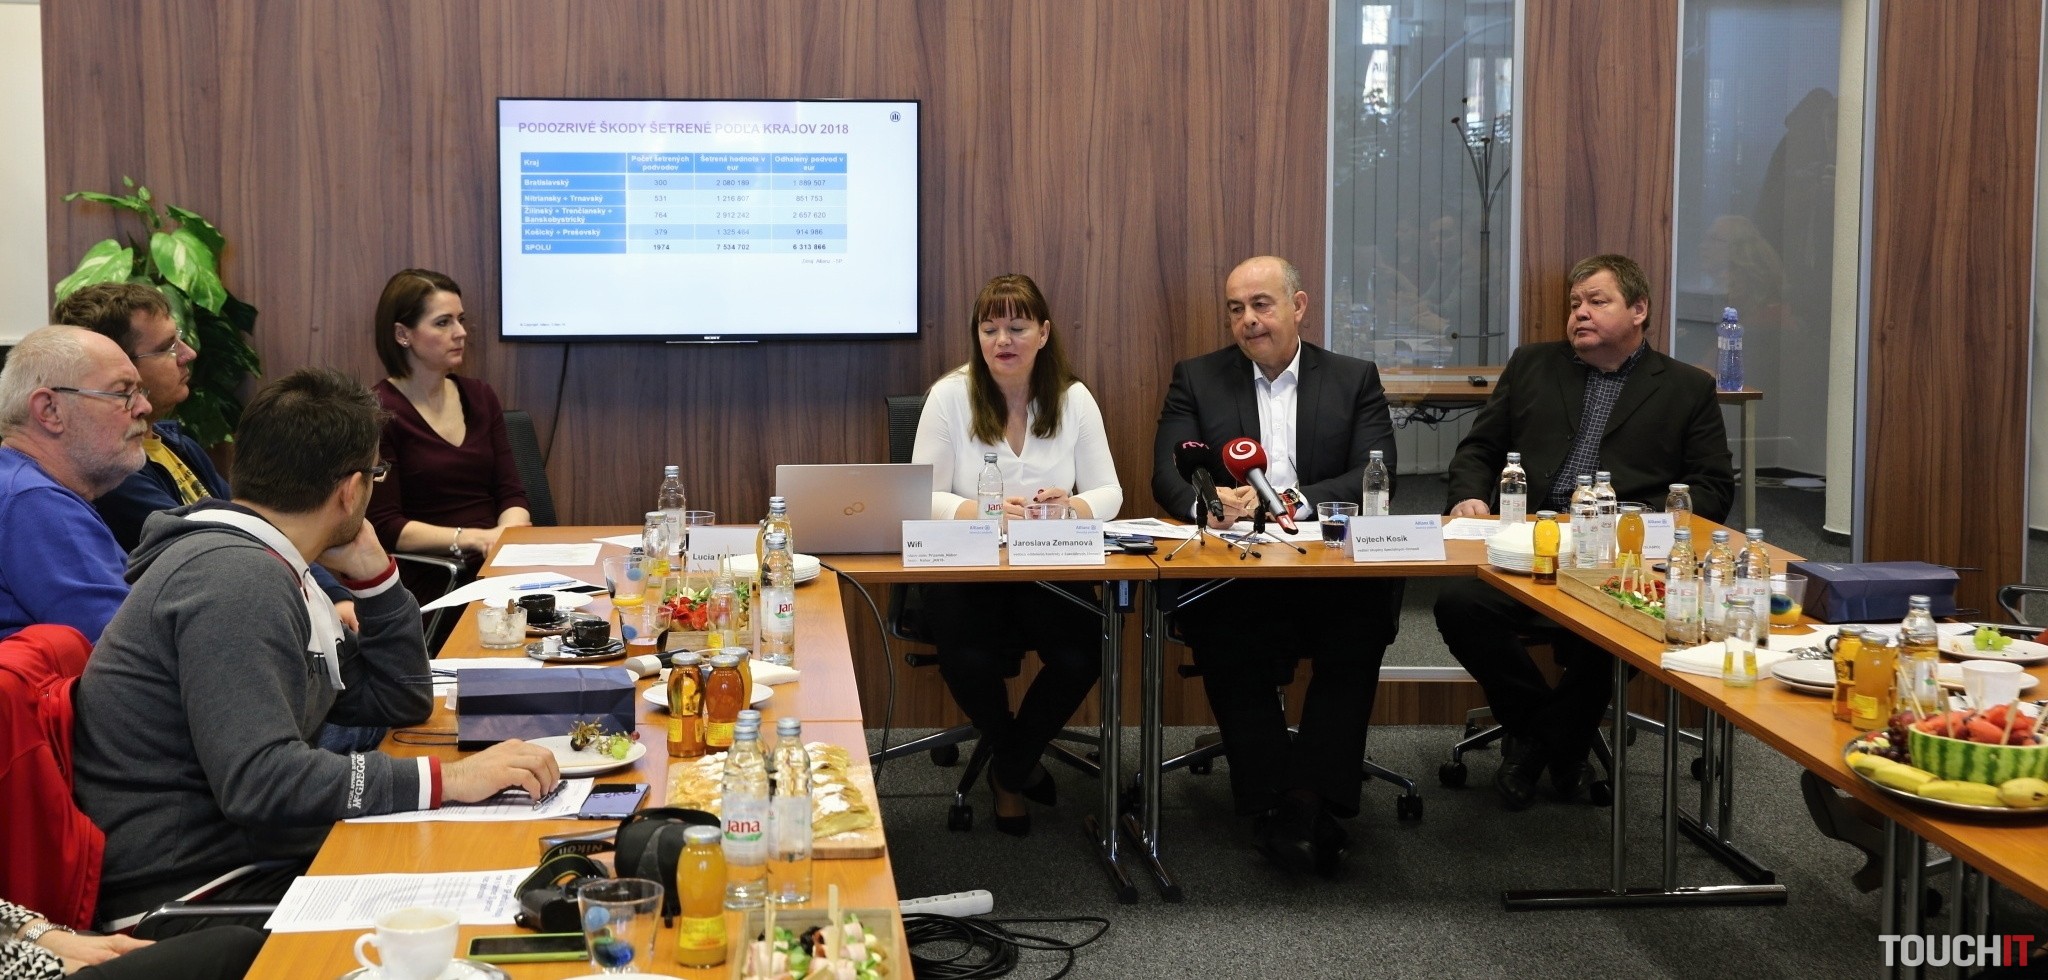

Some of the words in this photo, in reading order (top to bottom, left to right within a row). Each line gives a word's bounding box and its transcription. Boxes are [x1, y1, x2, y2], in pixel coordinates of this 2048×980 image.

[518, 121, 596, 133] PODOZRIVÉ
[600, 120, 646, 133] ŠKODY
[650, 120, 712, 134] ŠETRENÉ
[763, 123, 817, 134] KRAJOV
[820, 124, 849, 134] 2018
[523, 159, 540, 168] Kraj
[524, 178, 570, 188] Bratislavský
[654, 228, 668, 236] 379
[796, 228, 809, 236] 914
[524, 243, 552, 251] SPOLU
[653, 243, 670, 251] 1974
[722, 243, 736, 251] 534
[737, 243, 750, 251] 702
[1012, 539, 1051, 547] Jaroslava
[1052, 539, 1093, 547] Zemanová
[1355, 536, 1384, 544] Vojtech
[692, 553, 715, 561] Lucia
[778, 603, 793, 614] Jan
[727, 820, 760, 834] Jana
